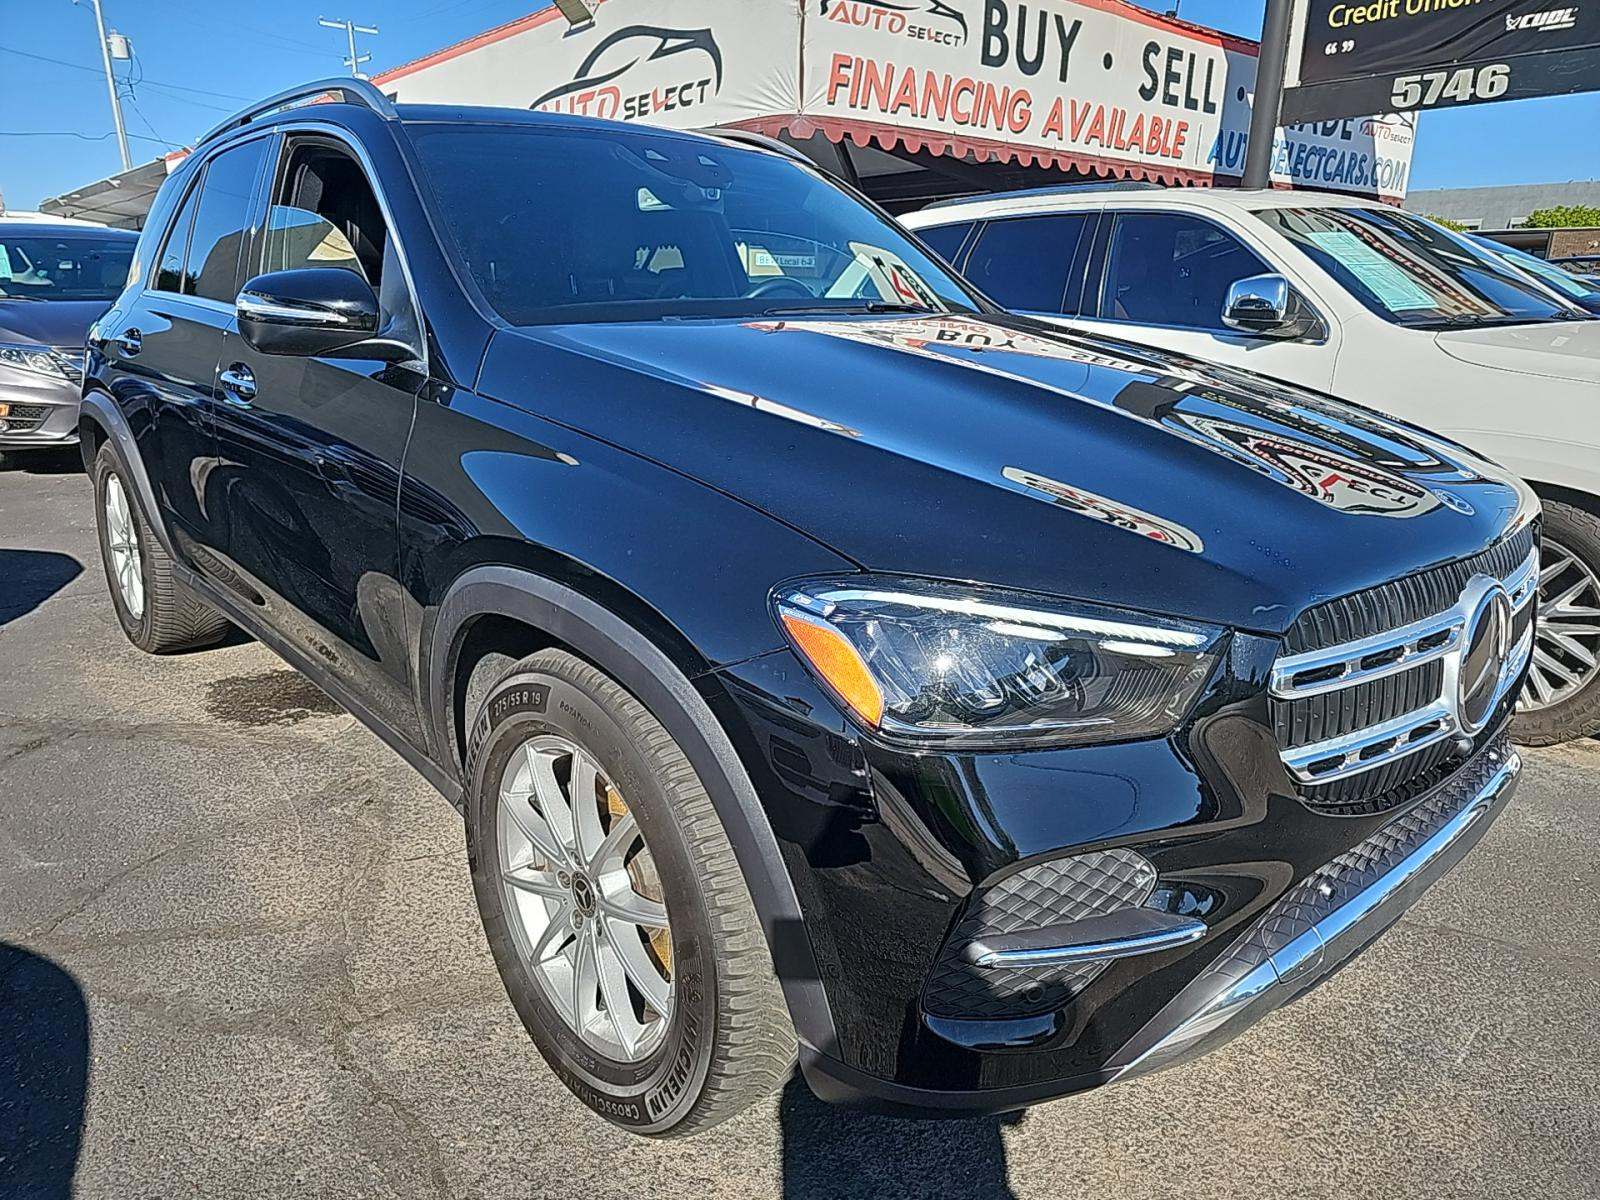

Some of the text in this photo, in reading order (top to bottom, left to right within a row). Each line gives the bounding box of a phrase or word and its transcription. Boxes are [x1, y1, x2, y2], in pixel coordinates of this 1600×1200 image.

[828, 1, 963, 47] AUTO SELECT
[1327, 0, 1398, 28] Credit
[981, 0, 1217, 115] BUY SELL
[624, 78, 711, 120] SELECT
[828, 53, 1189, 159] FINANCING AVAILABLE
[1390, 63, 1511, 108] 5746
[1361, 122, 1392, 140] AUTO
